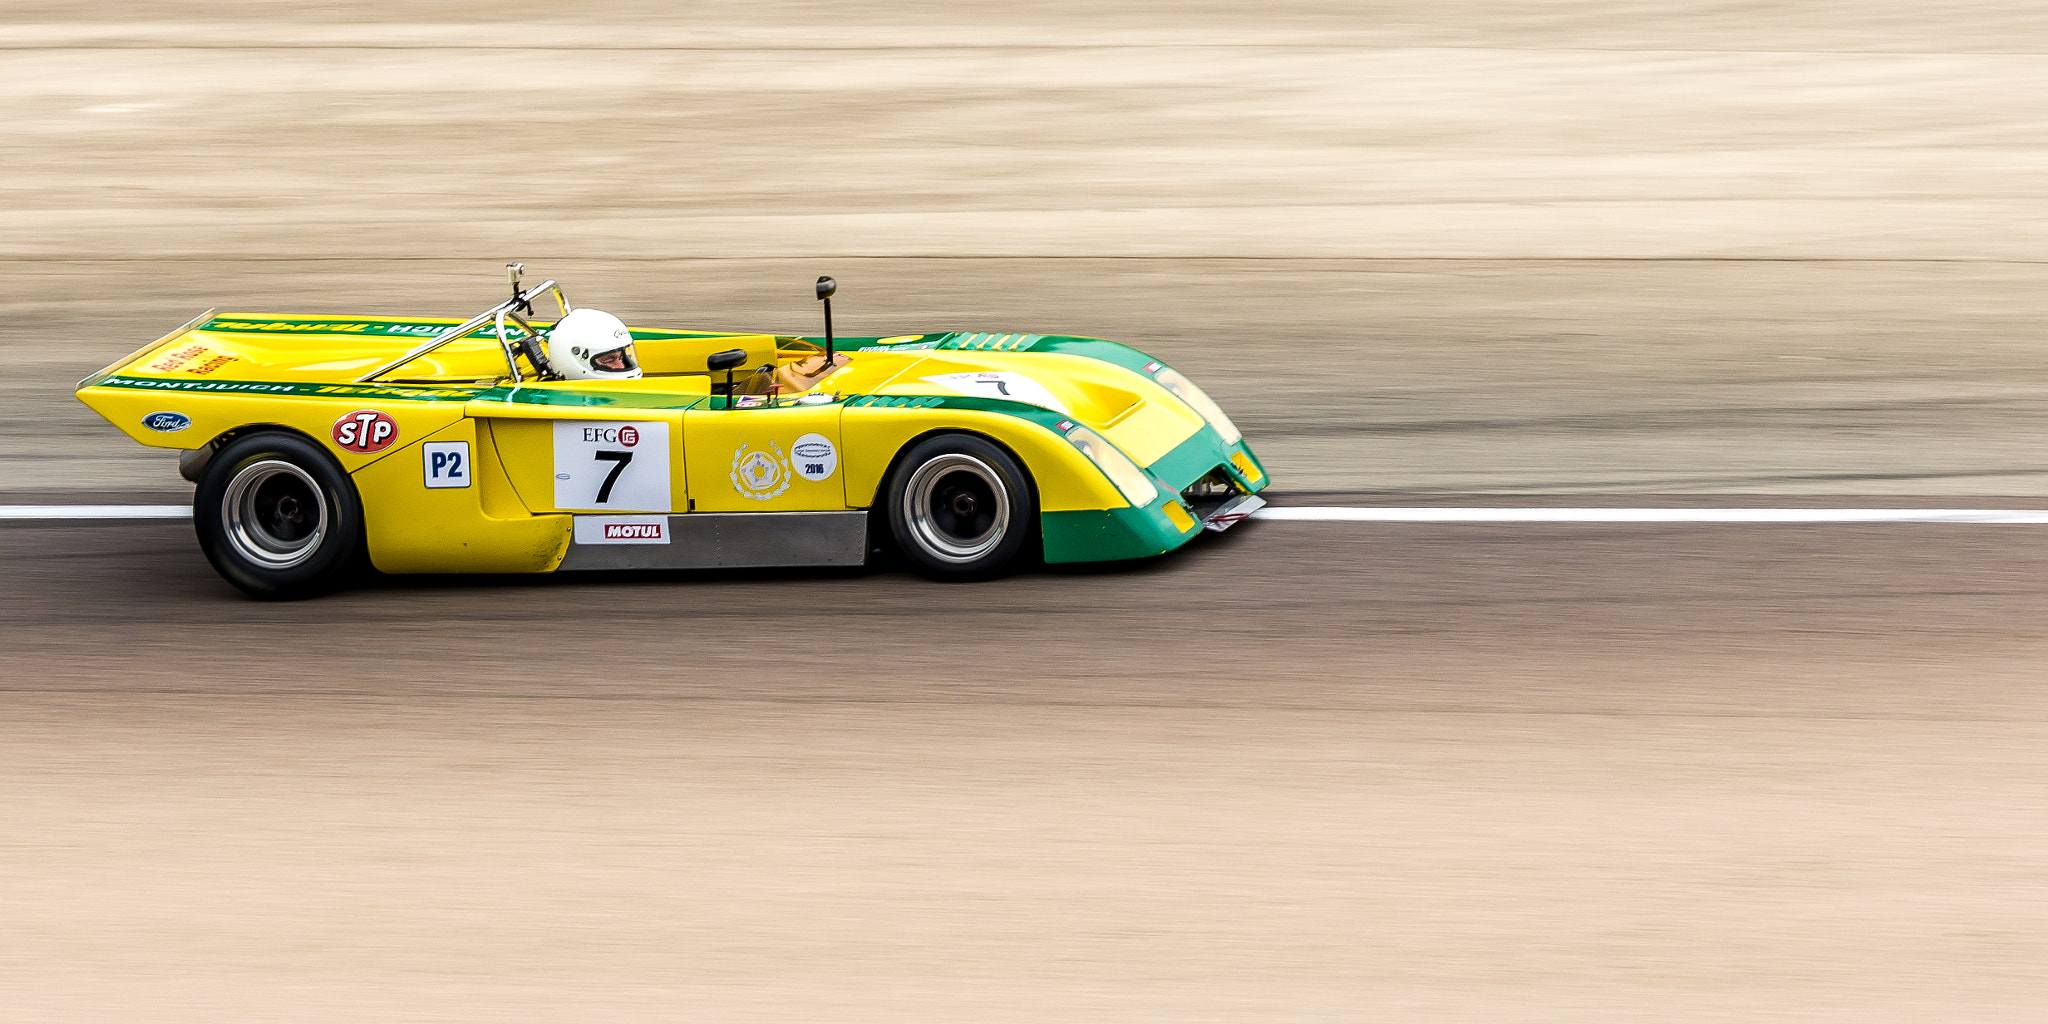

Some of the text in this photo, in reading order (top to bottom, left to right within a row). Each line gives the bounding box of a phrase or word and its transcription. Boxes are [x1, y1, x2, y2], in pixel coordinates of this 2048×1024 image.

[186, 355, 239, 375] Racing
[104, 378, 295, 392] MONTJUICH
[153, 414, 181, 428] Ford
[338, 413, 392, 448] STP
[582, 427, 617, 443] EFG
[431, 451, 463, 479] P2
[805, 463, 824, 475] 2016
[594, 450, 634, 504] 7
[607, 525, 660, 538] MOTUL
